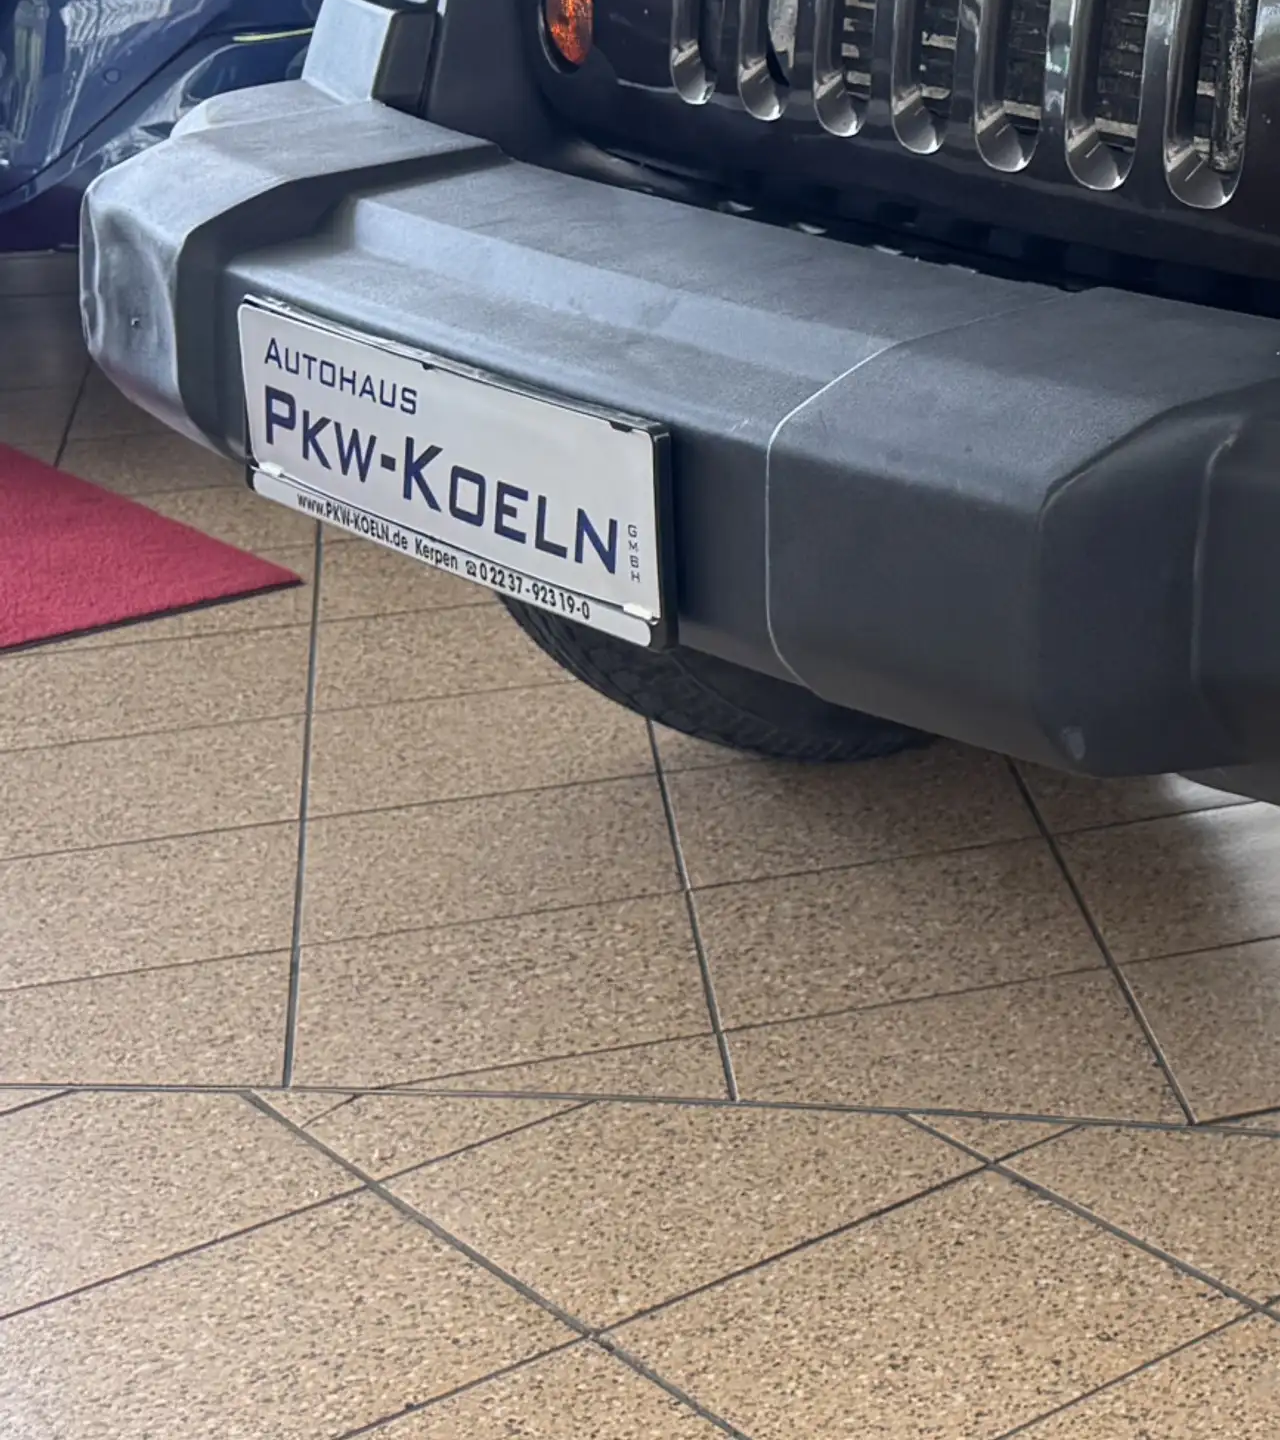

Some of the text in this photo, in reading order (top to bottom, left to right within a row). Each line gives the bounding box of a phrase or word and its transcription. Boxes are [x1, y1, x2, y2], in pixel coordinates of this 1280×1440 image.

[263, 336, 418, 416] AUTOHAUS
[264, 385, 619, 575] PKW-KOELN
[296, 493, 409, 551] www.PKW-KOELN.de
[415, 536, 458, 571] Kerpen
